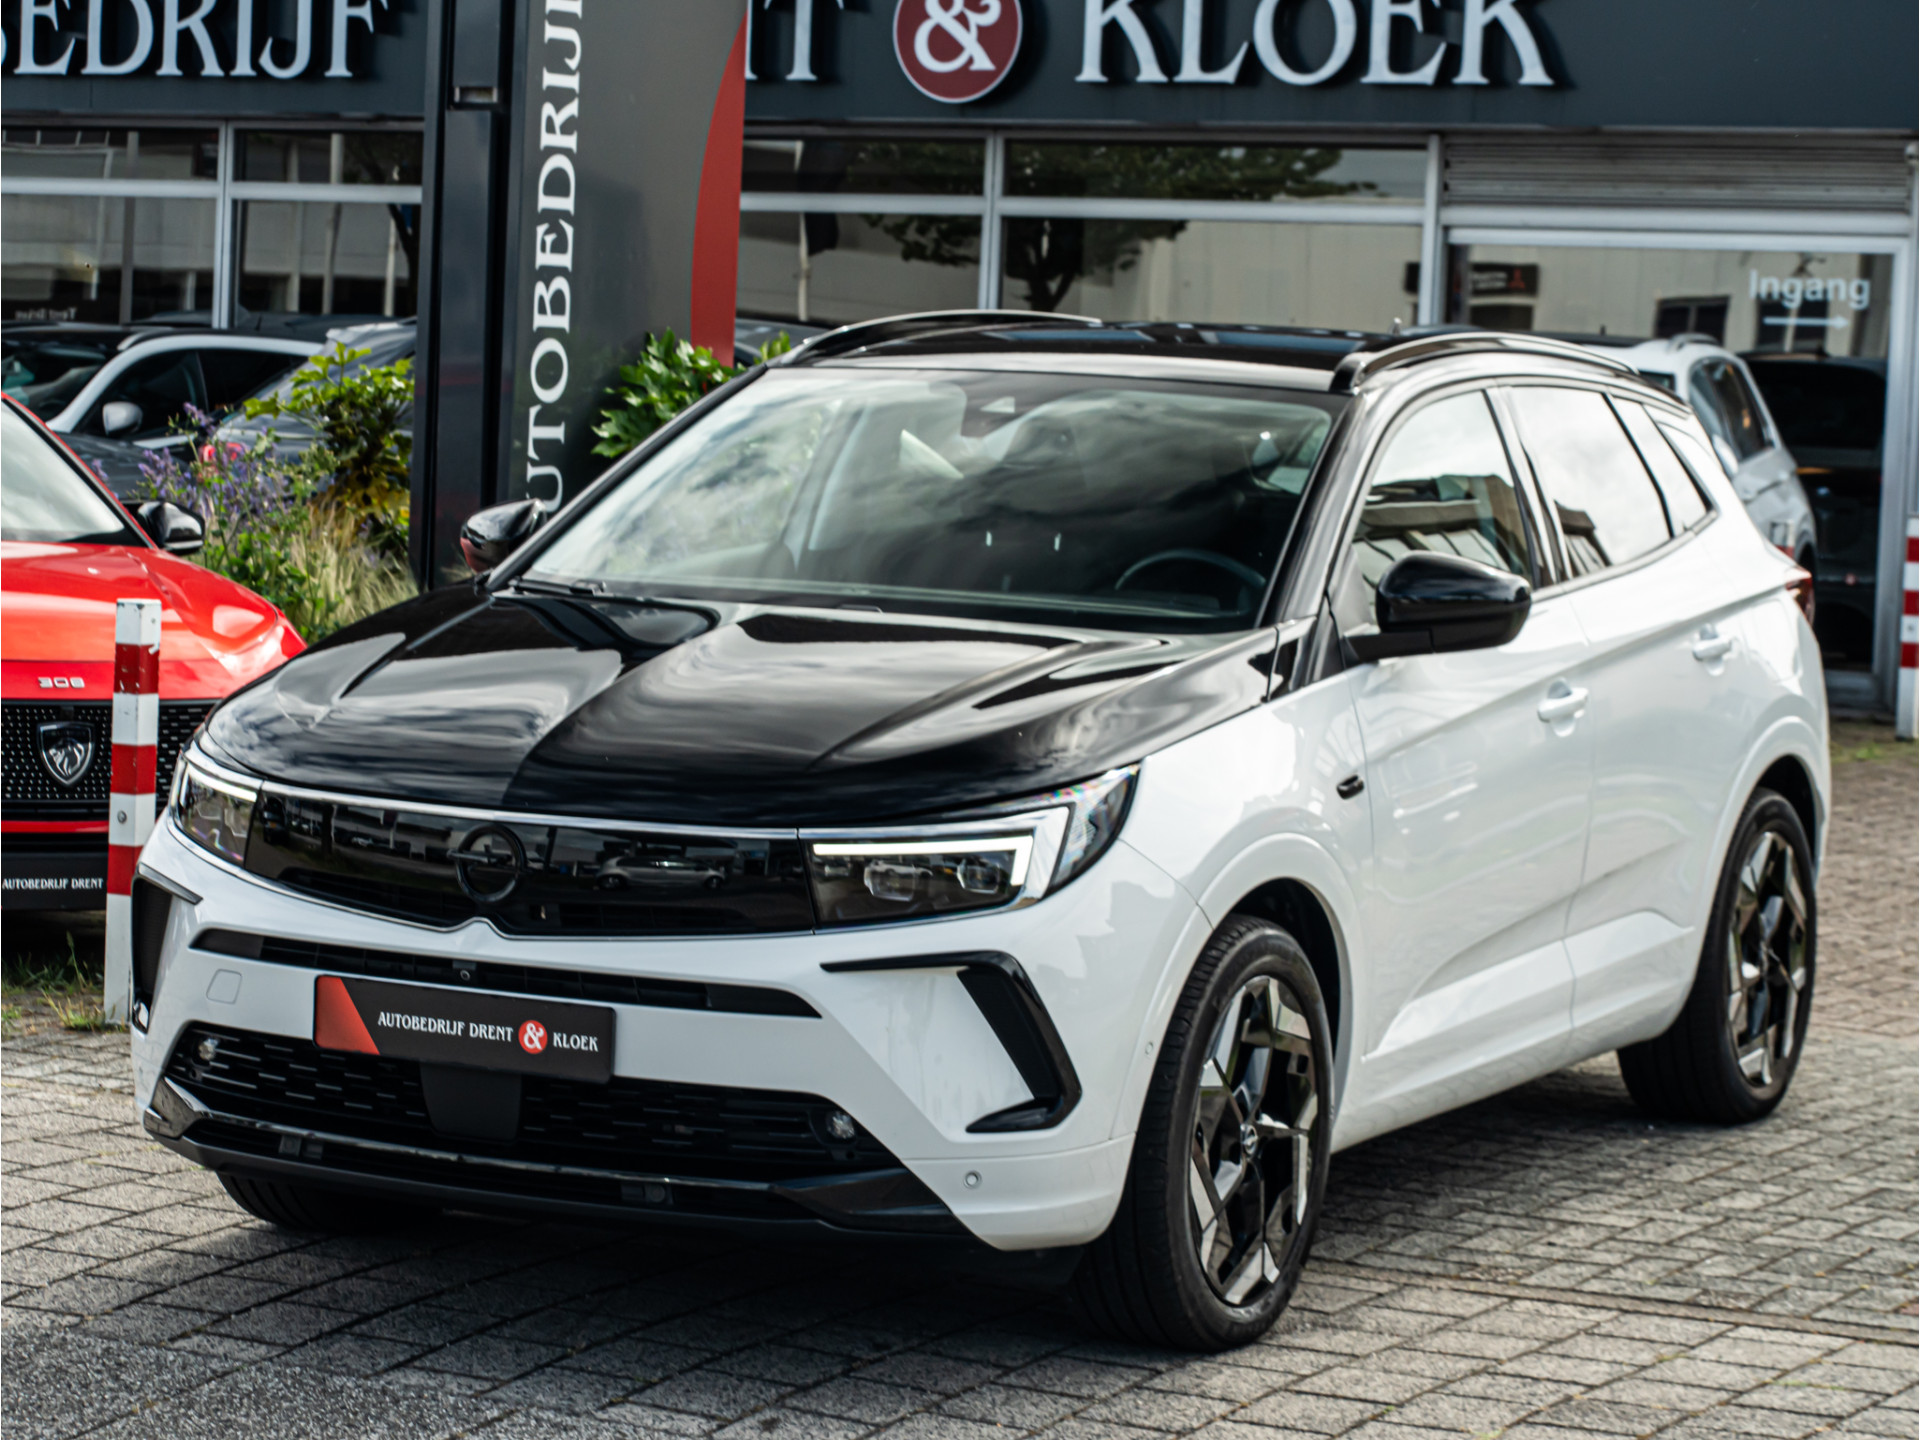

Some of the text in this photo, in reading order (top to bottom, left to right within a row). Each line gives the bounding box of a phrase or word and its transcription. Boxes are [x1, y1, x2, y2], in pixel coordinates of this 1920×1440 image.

[0, 0, 389, 79] EDRIJF
[913, 0, 1001, 73] &
[1075, 0, 1554, 86] KLOEK
[1749, 269, 1870, 310] Ingang
[1, 878, 104, 889] AUTOBEDRIJF DRENT
[378, 1010, 599, 1052] AUTOBEDRIJF DRENT & KLOEK
